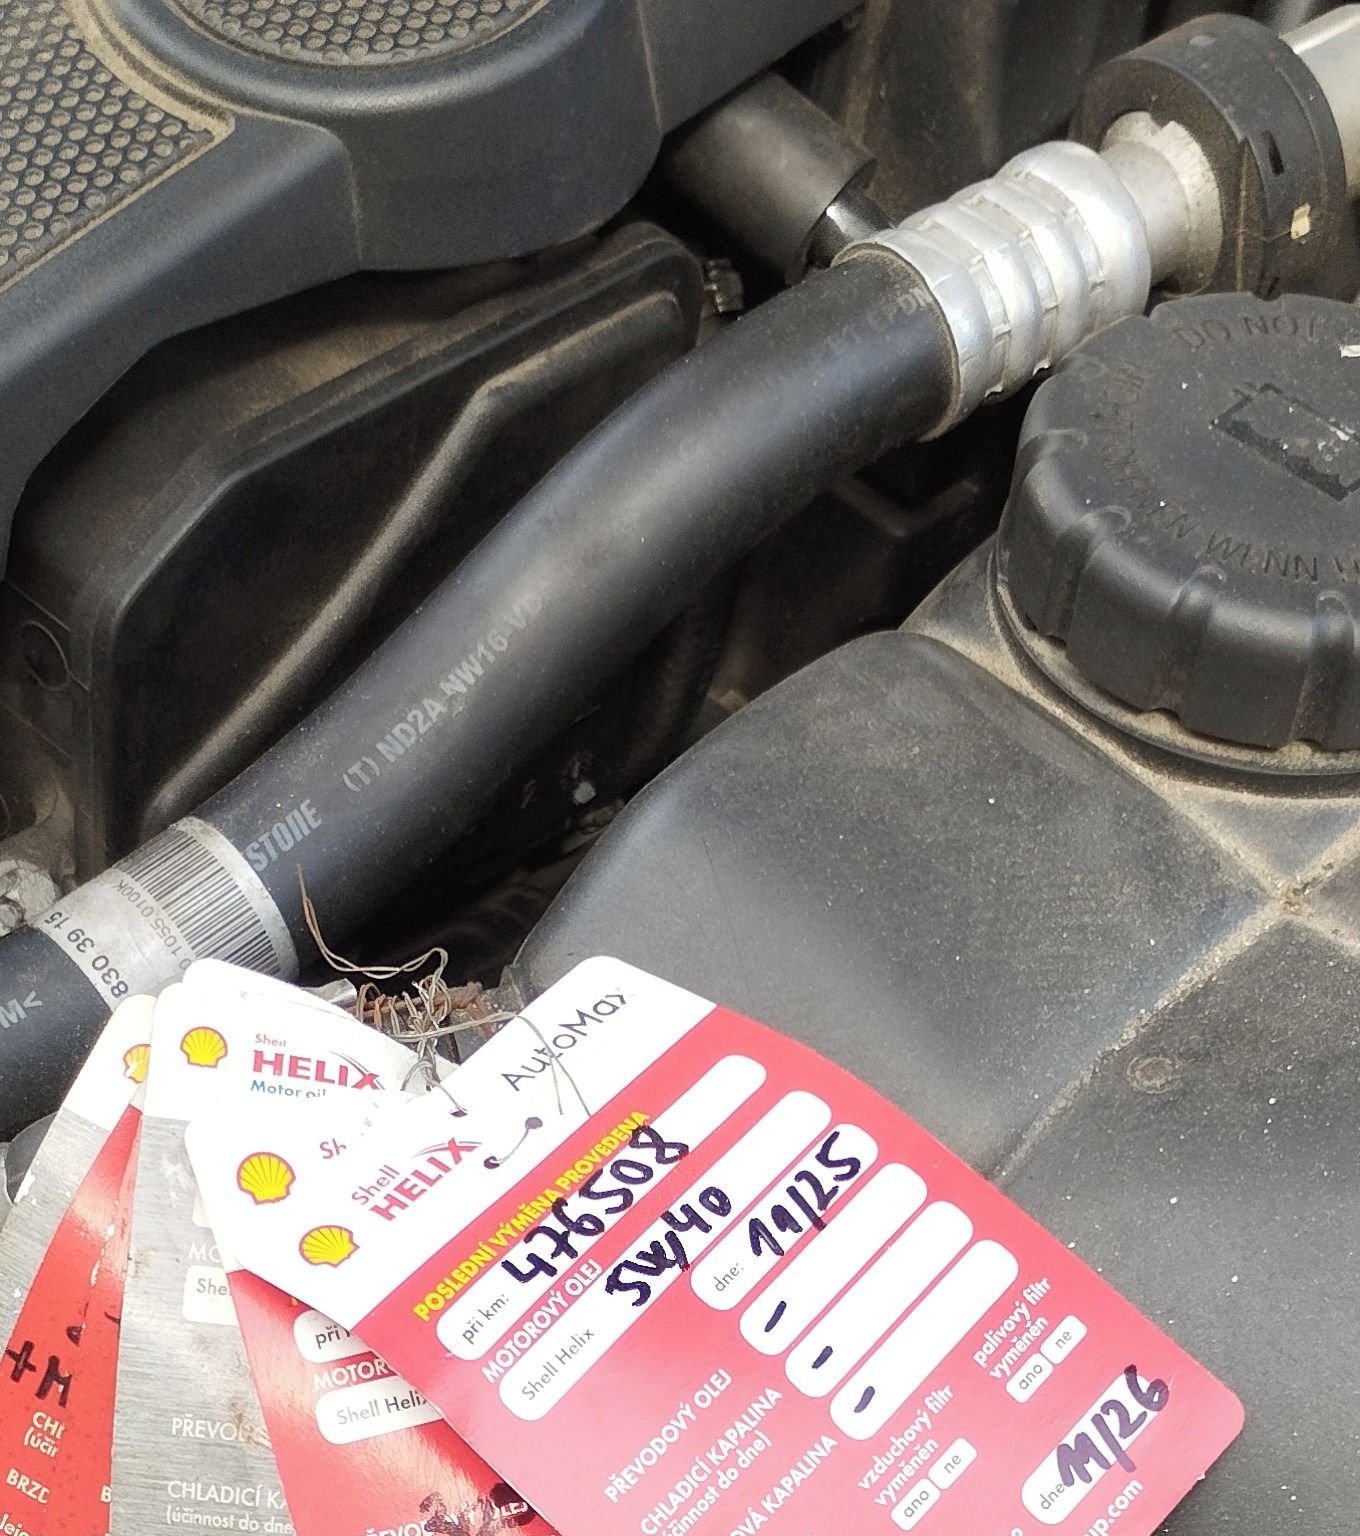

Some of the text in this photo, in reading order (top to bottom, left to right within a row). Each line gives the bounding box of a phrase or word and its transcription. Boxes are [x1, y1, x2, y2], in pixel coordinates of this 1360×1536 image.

[44, 910, 130, 999] 830 39 15
[250, 1079, 303, 1098] Motor
[252, 1049, 381, 1091] HELIX
[351, 1164, 401, 1206] Shell
[368, 1136, 480, 1222] HELIX
[501, 1123, 690, 1284] 476508
[412, 1109, 652, 1323] POSLEDNÍ VÝMĚNA PROVEDENA
[713, 1266, 744, 1294] dne:
[460, 1293, 510, 1345] při km:
[480, 1257, 604, 1384] MOTOROVÝ OLEJ
[972, 1276, 1052, 1371] palivový filtr
[988, 1314, 1051, 1382] vyměněn
[521, 1326, 597, 1402] Shell Helix
[1017, 1329, 1075, 1393] ano ne
[336, 1398, 381, 1426] Shell
[602, 1367, 734, 1504] PŘEVODOVÝ OLEJ
[705, 1386, 785, 1468] KAPALINA
[856, 1384, 957, 1493] vzduchový filtr
[167, 1480, 263, 1508] CHLADICÍ
[716, 1460, 740, 1492] do
[759, 1435, 840, 1518] KAPALINA
[873, 1435, 940, 1508] vyměněn
[902, 1451, 964, 1520] ano ne
[238, 1510, 260, 1532] do
